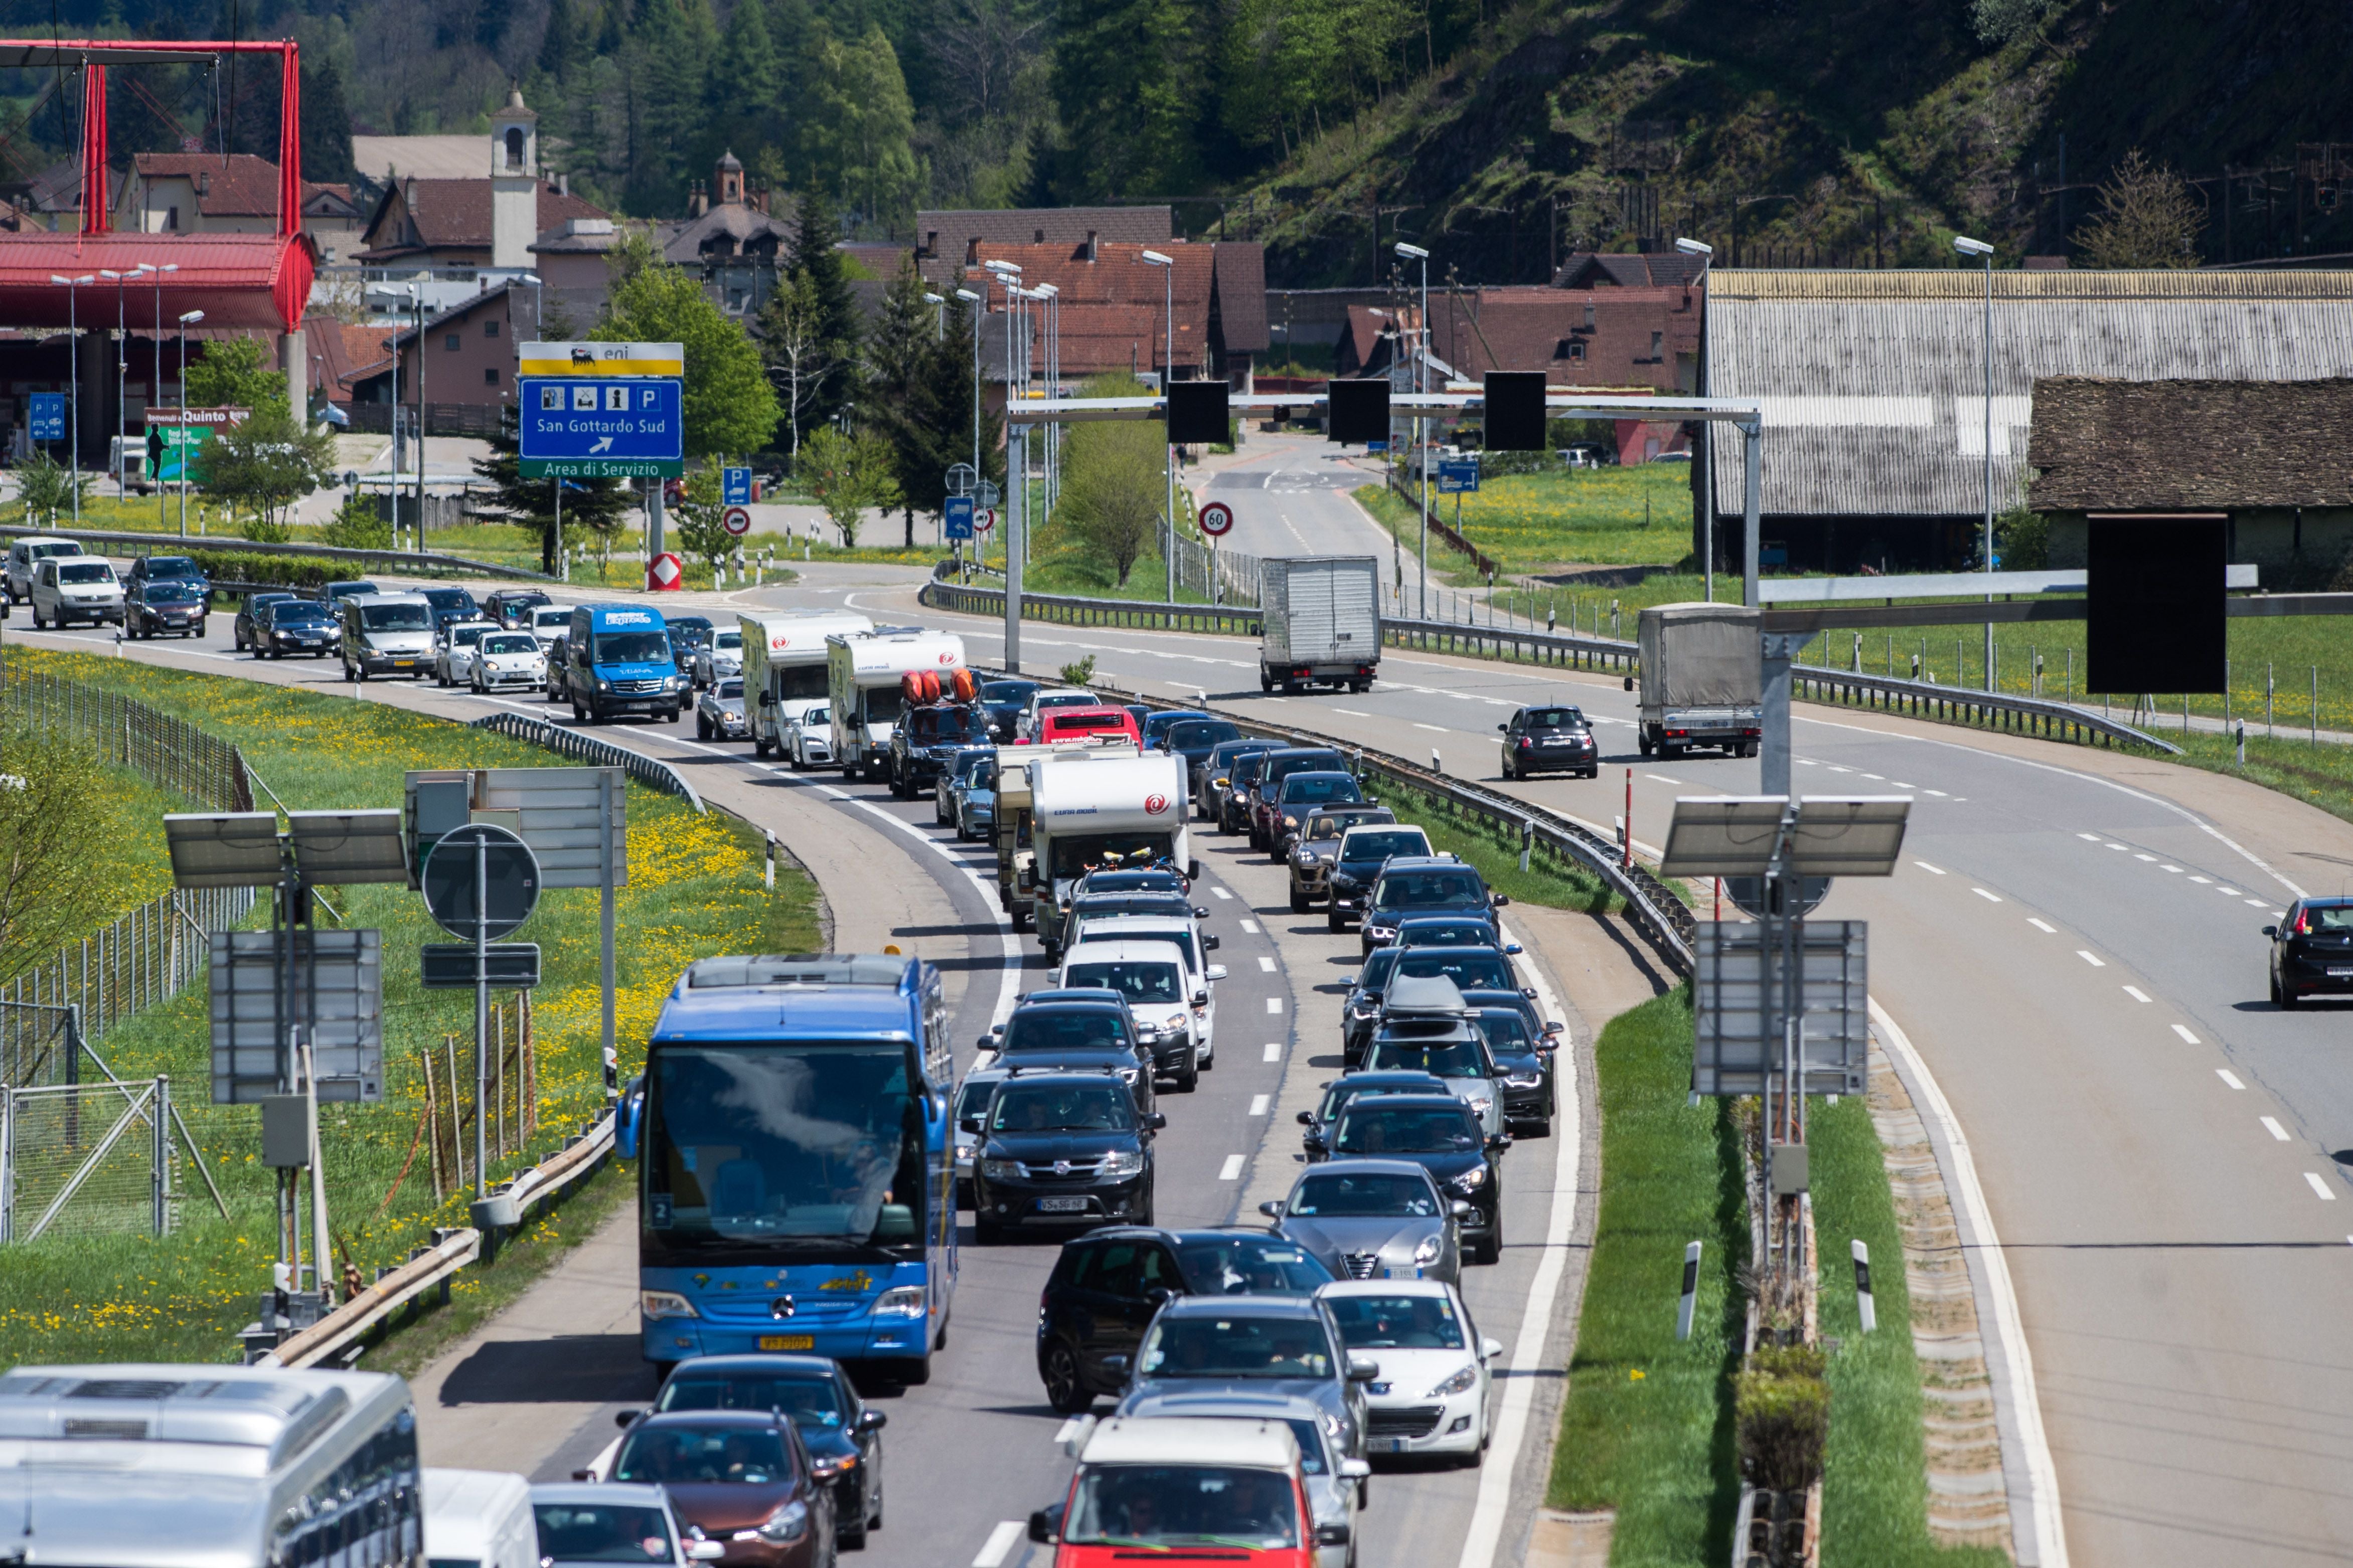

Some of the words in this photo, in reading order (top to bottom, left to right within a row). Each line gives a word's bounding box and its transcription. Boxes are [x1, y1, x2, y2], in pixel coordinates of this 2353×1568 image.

[604, 346, 629, 360] eni
[643, 390, 655, 408] P
[36, 404, 42, 412] P
[53, 404, 59, 412] P
[184, 410, 226, 423] Quinto
[537, 419, 563, 432] San
[569, 419, 634, 433] Gottardo
[639, 419, 665, 433] Sud
[545, 463, 577, 475] Area
[583, 462, 596, 475] di
[602, 463, 658, 475] Servizio
[732, 470, 742, 485] P
[1209, 513, 1223, 525] 60
[1076, 806, 1097, 814] MOBIL
[656, 1204, 666, 1218] 2
